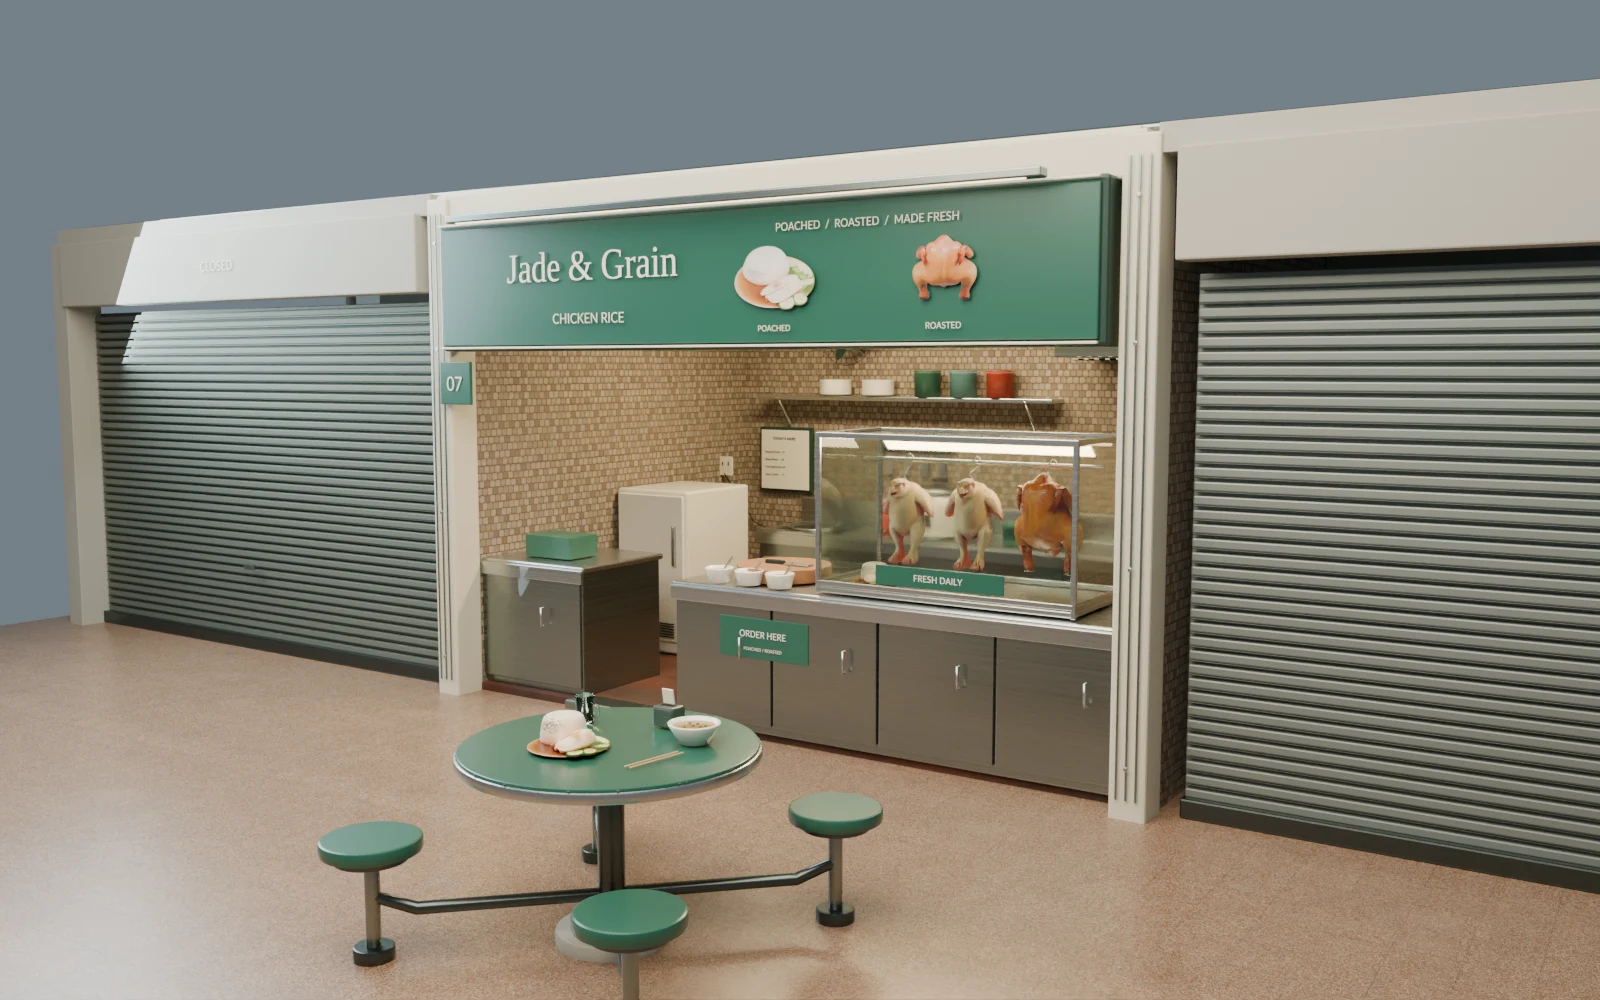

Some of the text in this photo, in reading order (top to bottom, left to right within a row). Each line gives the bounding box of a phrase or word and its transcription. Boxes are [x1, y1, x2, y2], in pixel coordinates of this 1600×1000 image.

[775, 210, 960, 232] POACHED / ROASTED / MADE FRESH
[200, 260, 233, 272] CLOSED
[506, 246, 678, 284] Jade & Grain
[552, 311, 625, 325] CHICKEN RICE
[757, 324, 791, 332] POACHED
[924, 320, 962, 330] ROASTED
[446, 376, 462, 391] 07
[912, 574, 963, 587] FRESH DAILY
[739, 629, 786, 642] ORDER HERE
